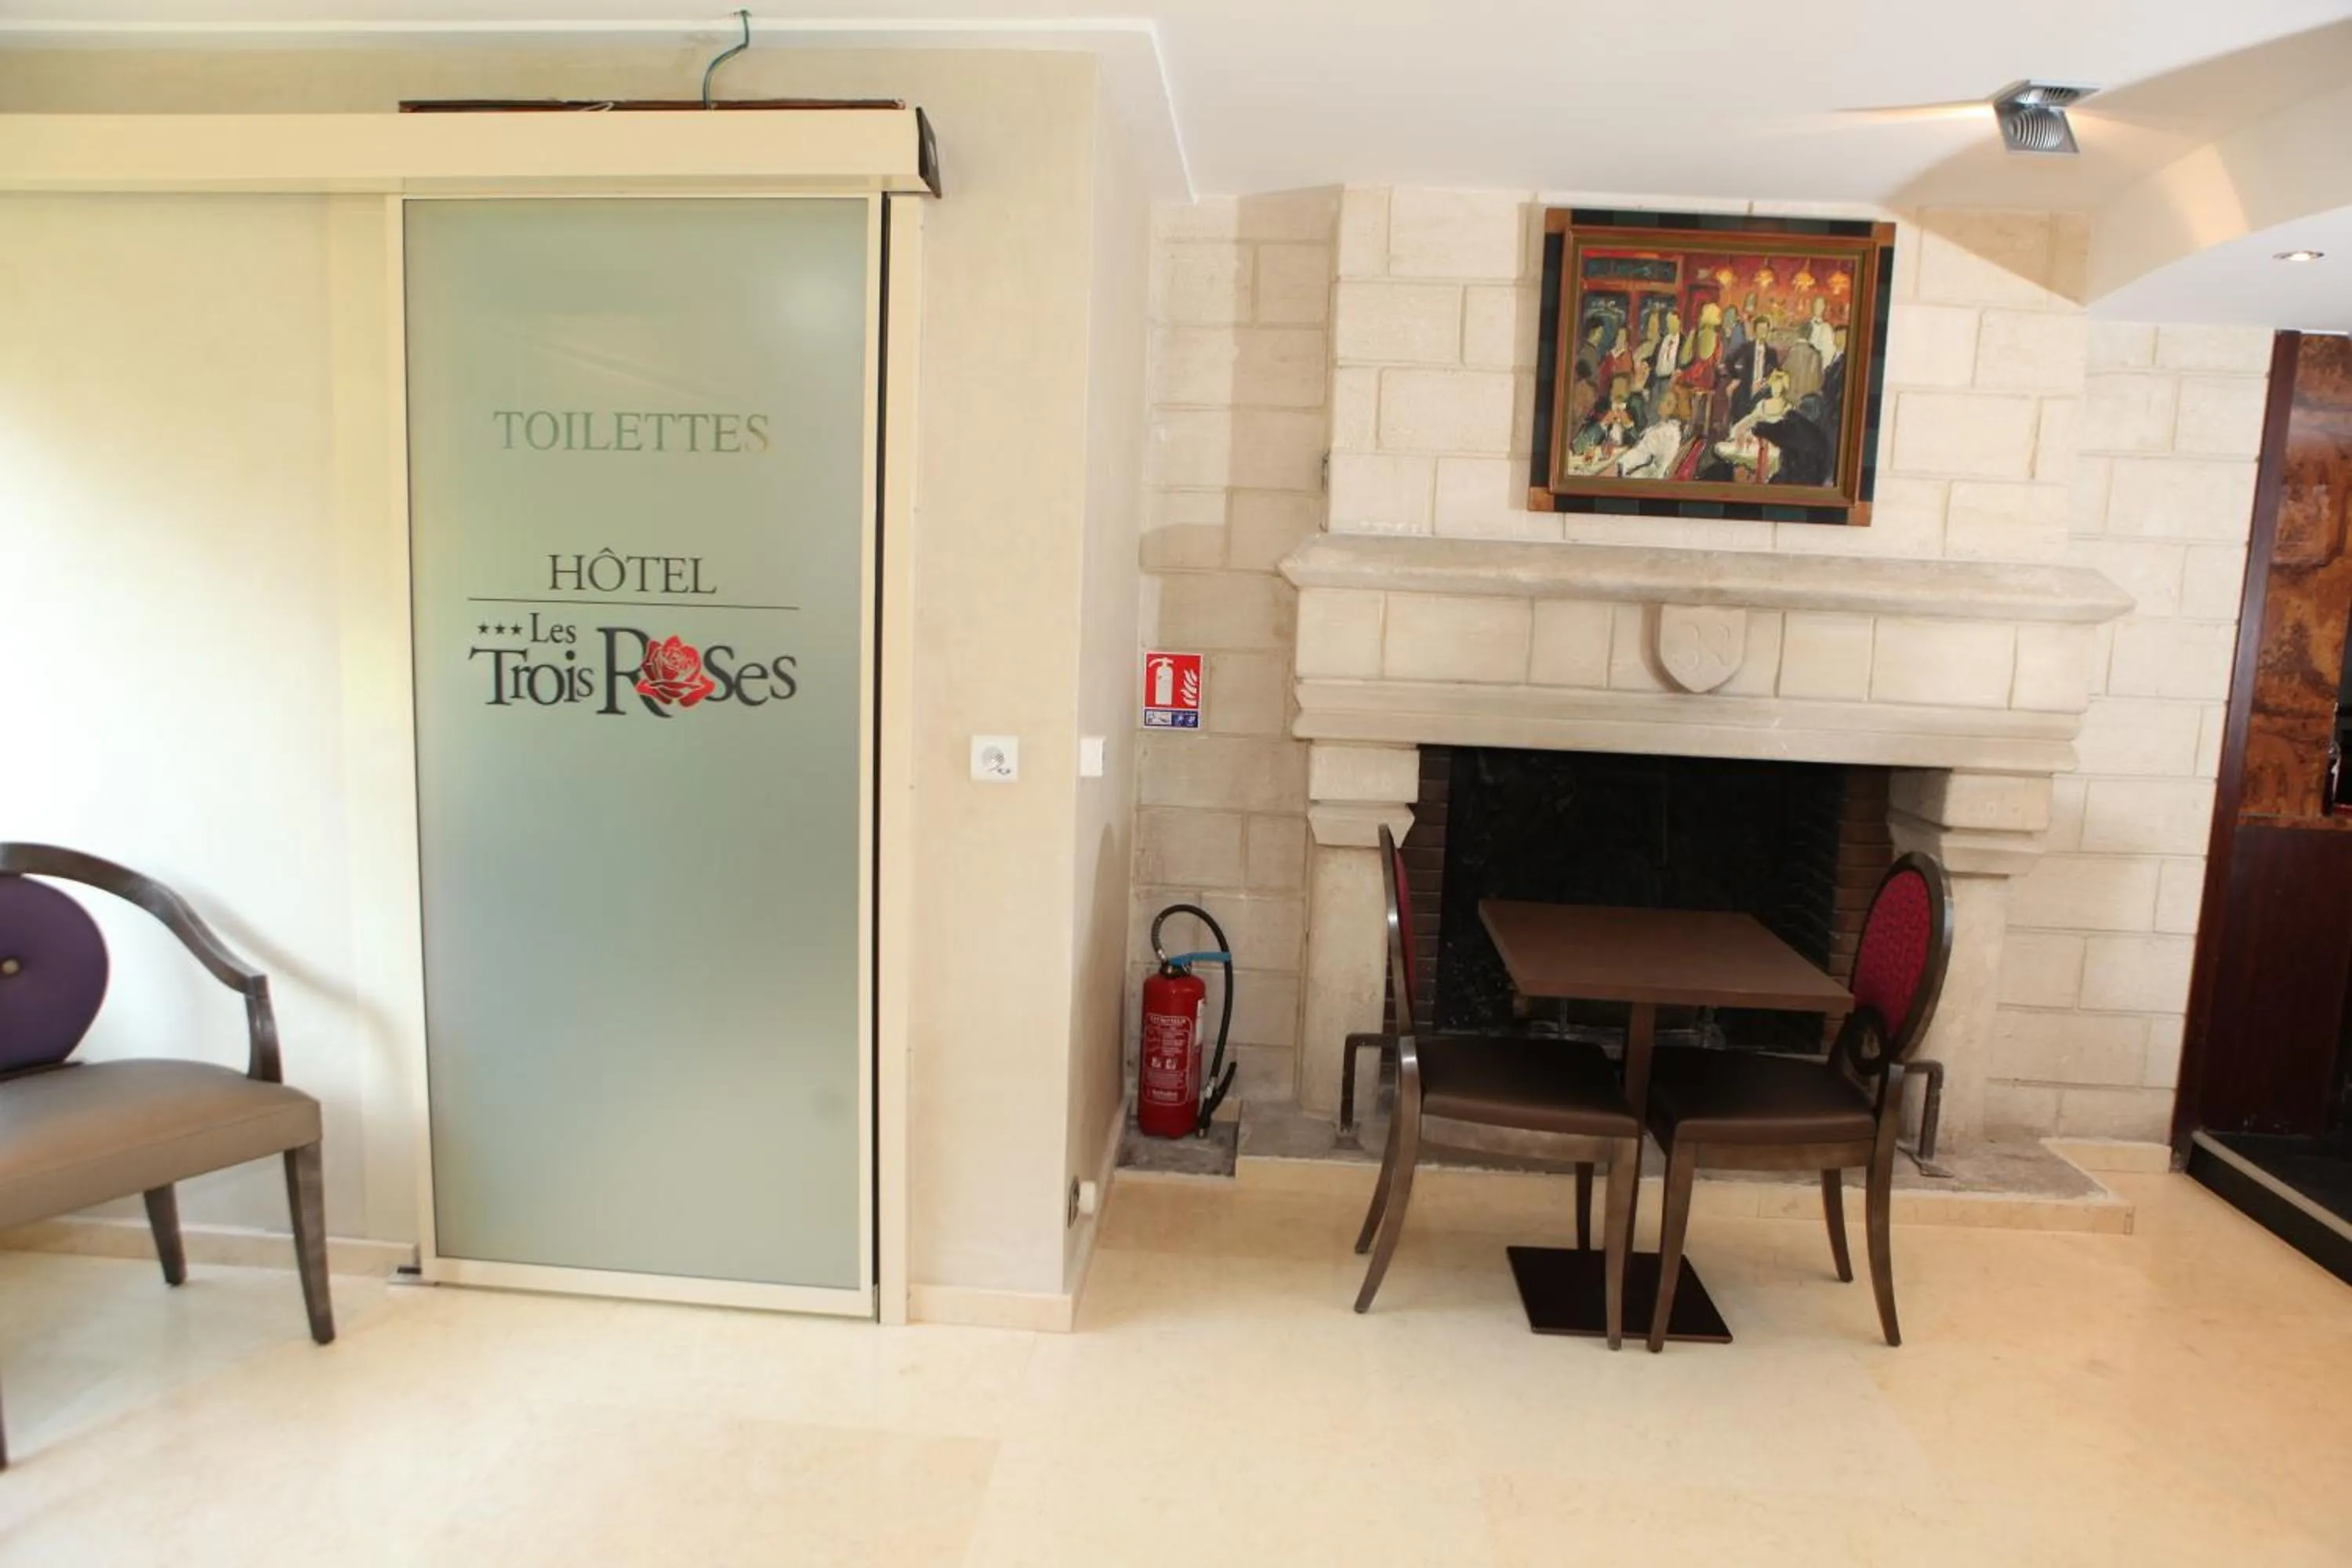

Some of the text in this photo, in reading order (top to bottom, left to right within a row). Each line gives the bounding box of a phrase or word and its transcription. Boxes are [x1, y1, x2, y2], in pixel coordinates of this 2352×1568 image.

[493, 410, 771, 453] TOILETTES
[547, 546, 717, 594] HÔTEL
[529, 612, 577, 644] Les
[468, 646, 594, 706] Trois
